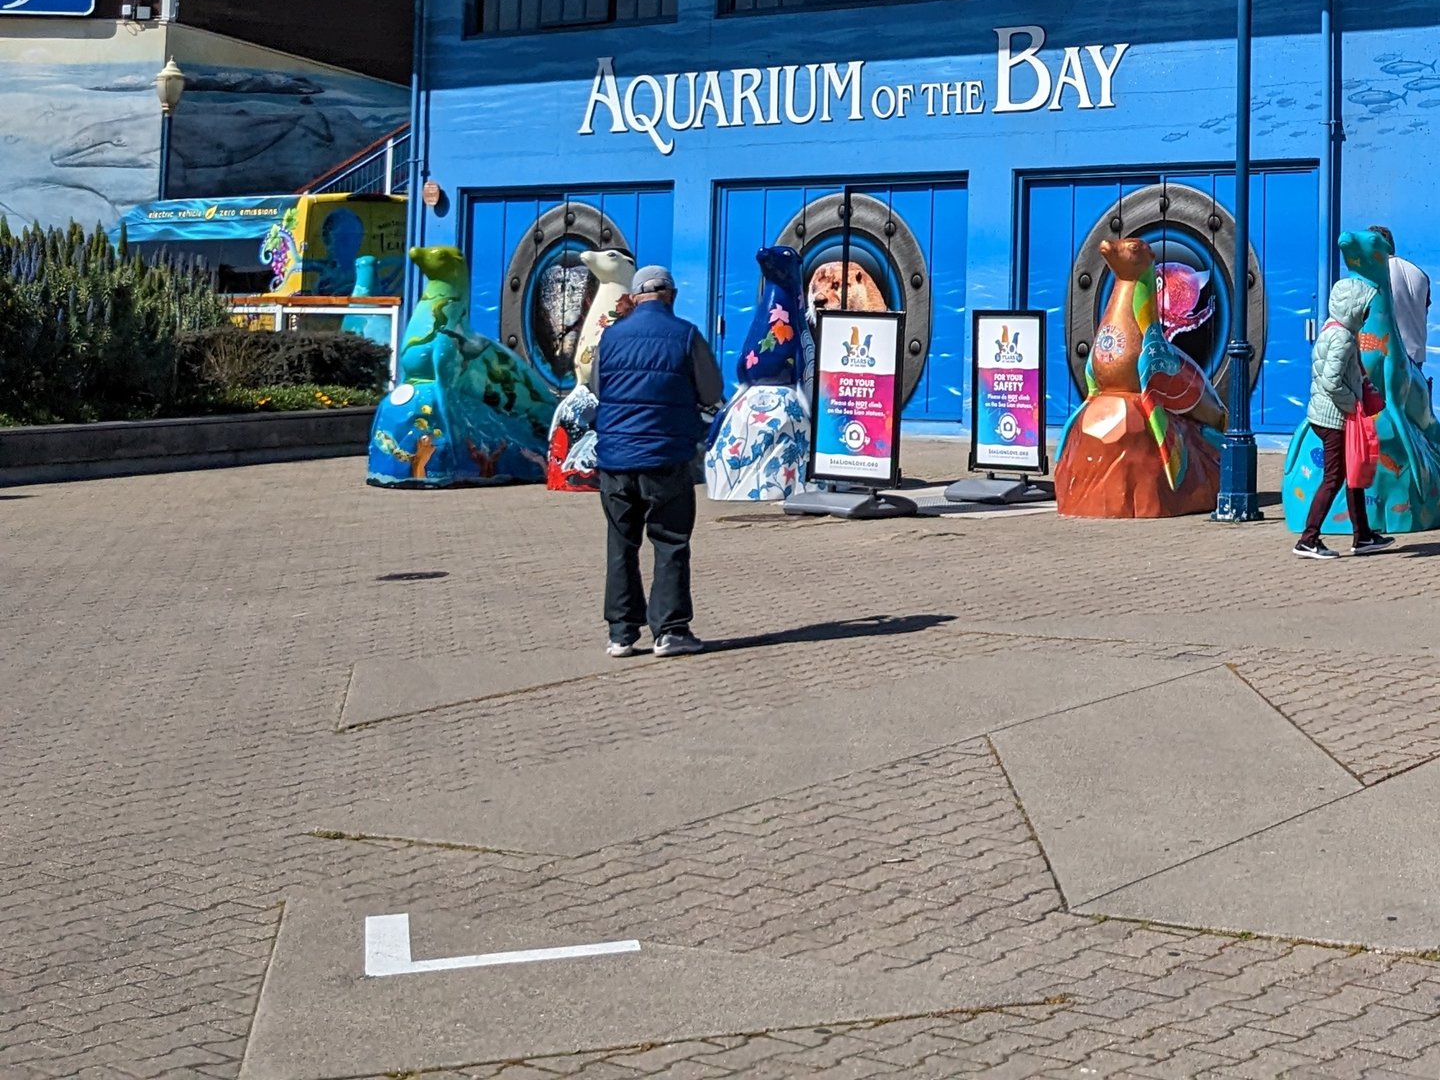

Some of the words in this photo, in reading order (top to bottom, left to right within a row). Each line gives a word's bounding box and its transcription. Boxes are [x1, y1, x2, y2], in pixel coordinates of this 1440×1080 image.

[577, 56, 866, 156] AQUARIUM
[871, 84, 915, 119] OF
[921, 80, 985, 116] THE
[992, 25, 1131, 114] BAY
[148, 211, 174, 219] electric
[178, 208, 202, 218] vehicle
[219, 209, 236, 217] zero
[239, 207, 278, 217] emissions
[839, 378, 853, 386] FOR
[855, 378, 875, 387] YOUR
[993, 381, 1024, 391] SAFETY
[838, 386, 875, 398] SAFETY
